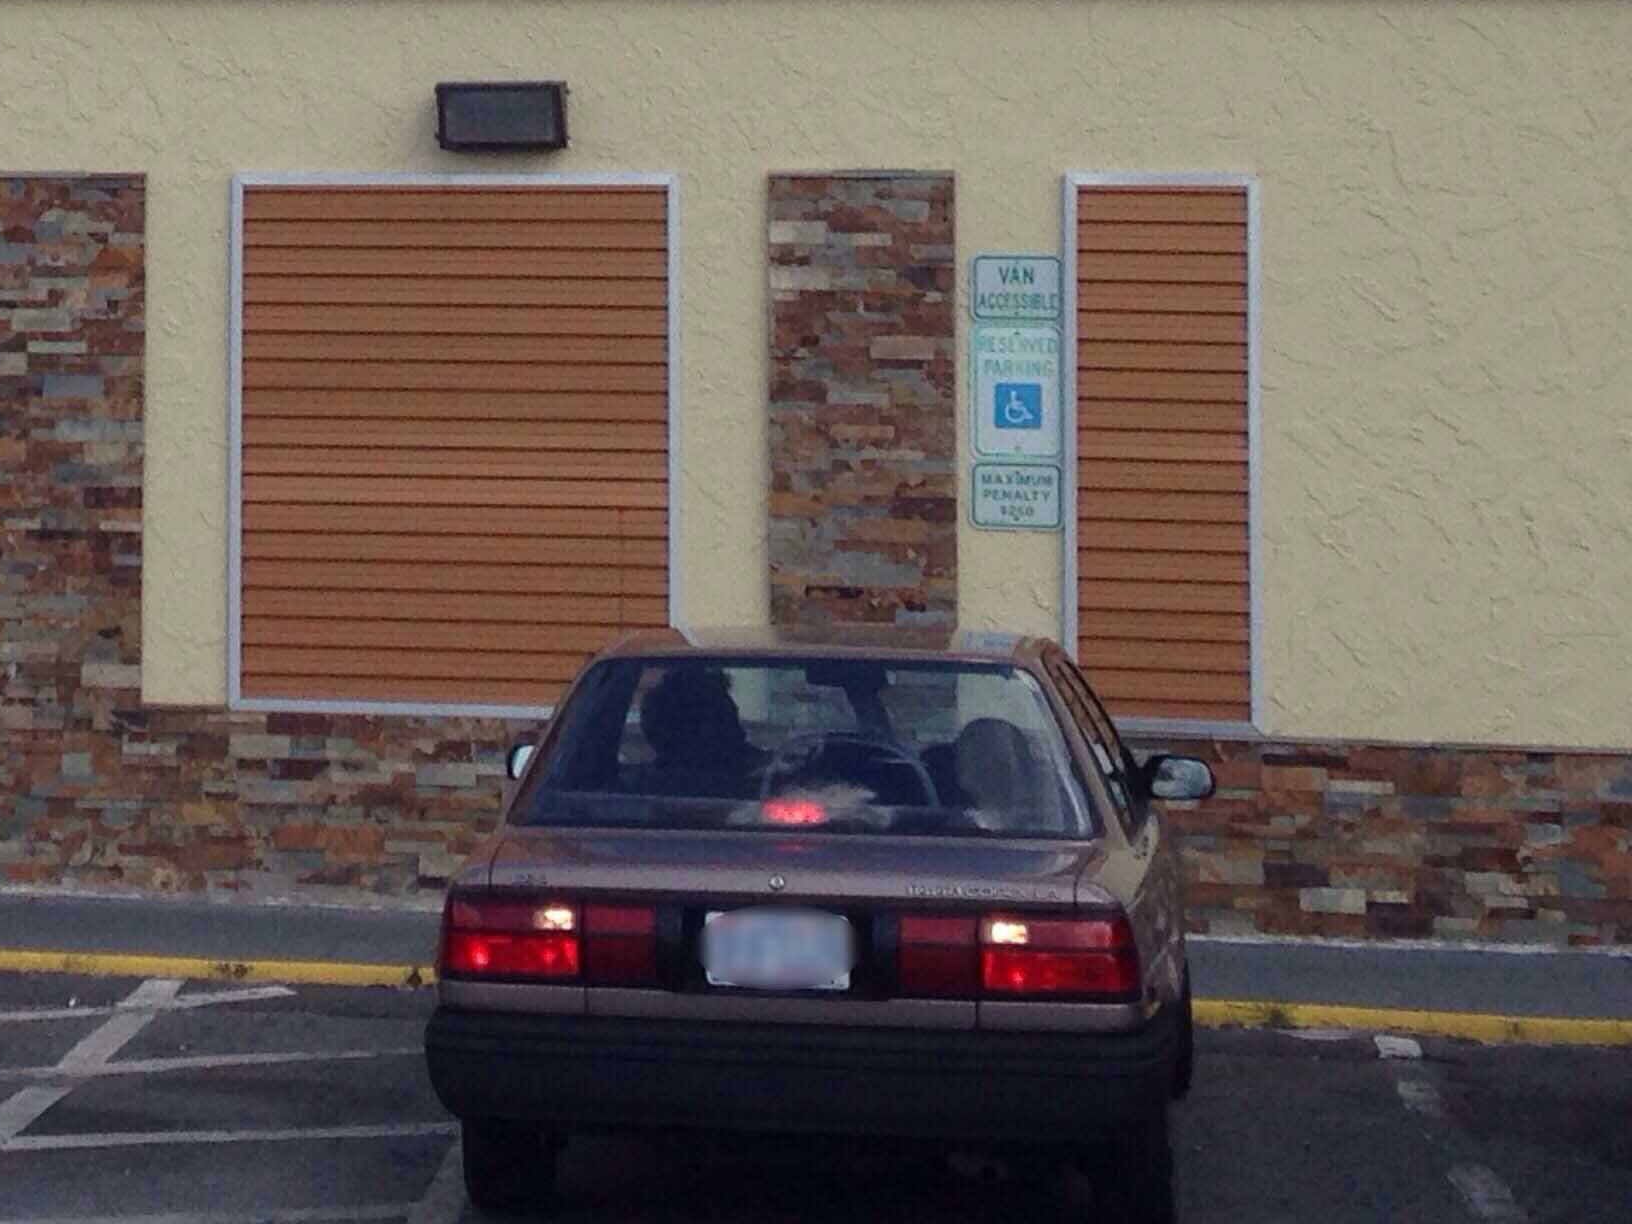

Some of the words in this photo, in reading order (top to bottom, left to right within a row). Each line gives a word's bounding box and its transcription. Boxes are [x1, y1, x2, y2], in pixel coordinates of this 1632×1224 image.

[998, 266, 1035, 285] VAN
[977, 292, 1060, 310] ACCESSIBLE
[976, 336, 1058, 354] RESERVED
[983, 359, 1055, 378] PARKING
[981, 473, 1054, 486] MAXIMUM
[983, 488, 1051, 502] PENALTY
